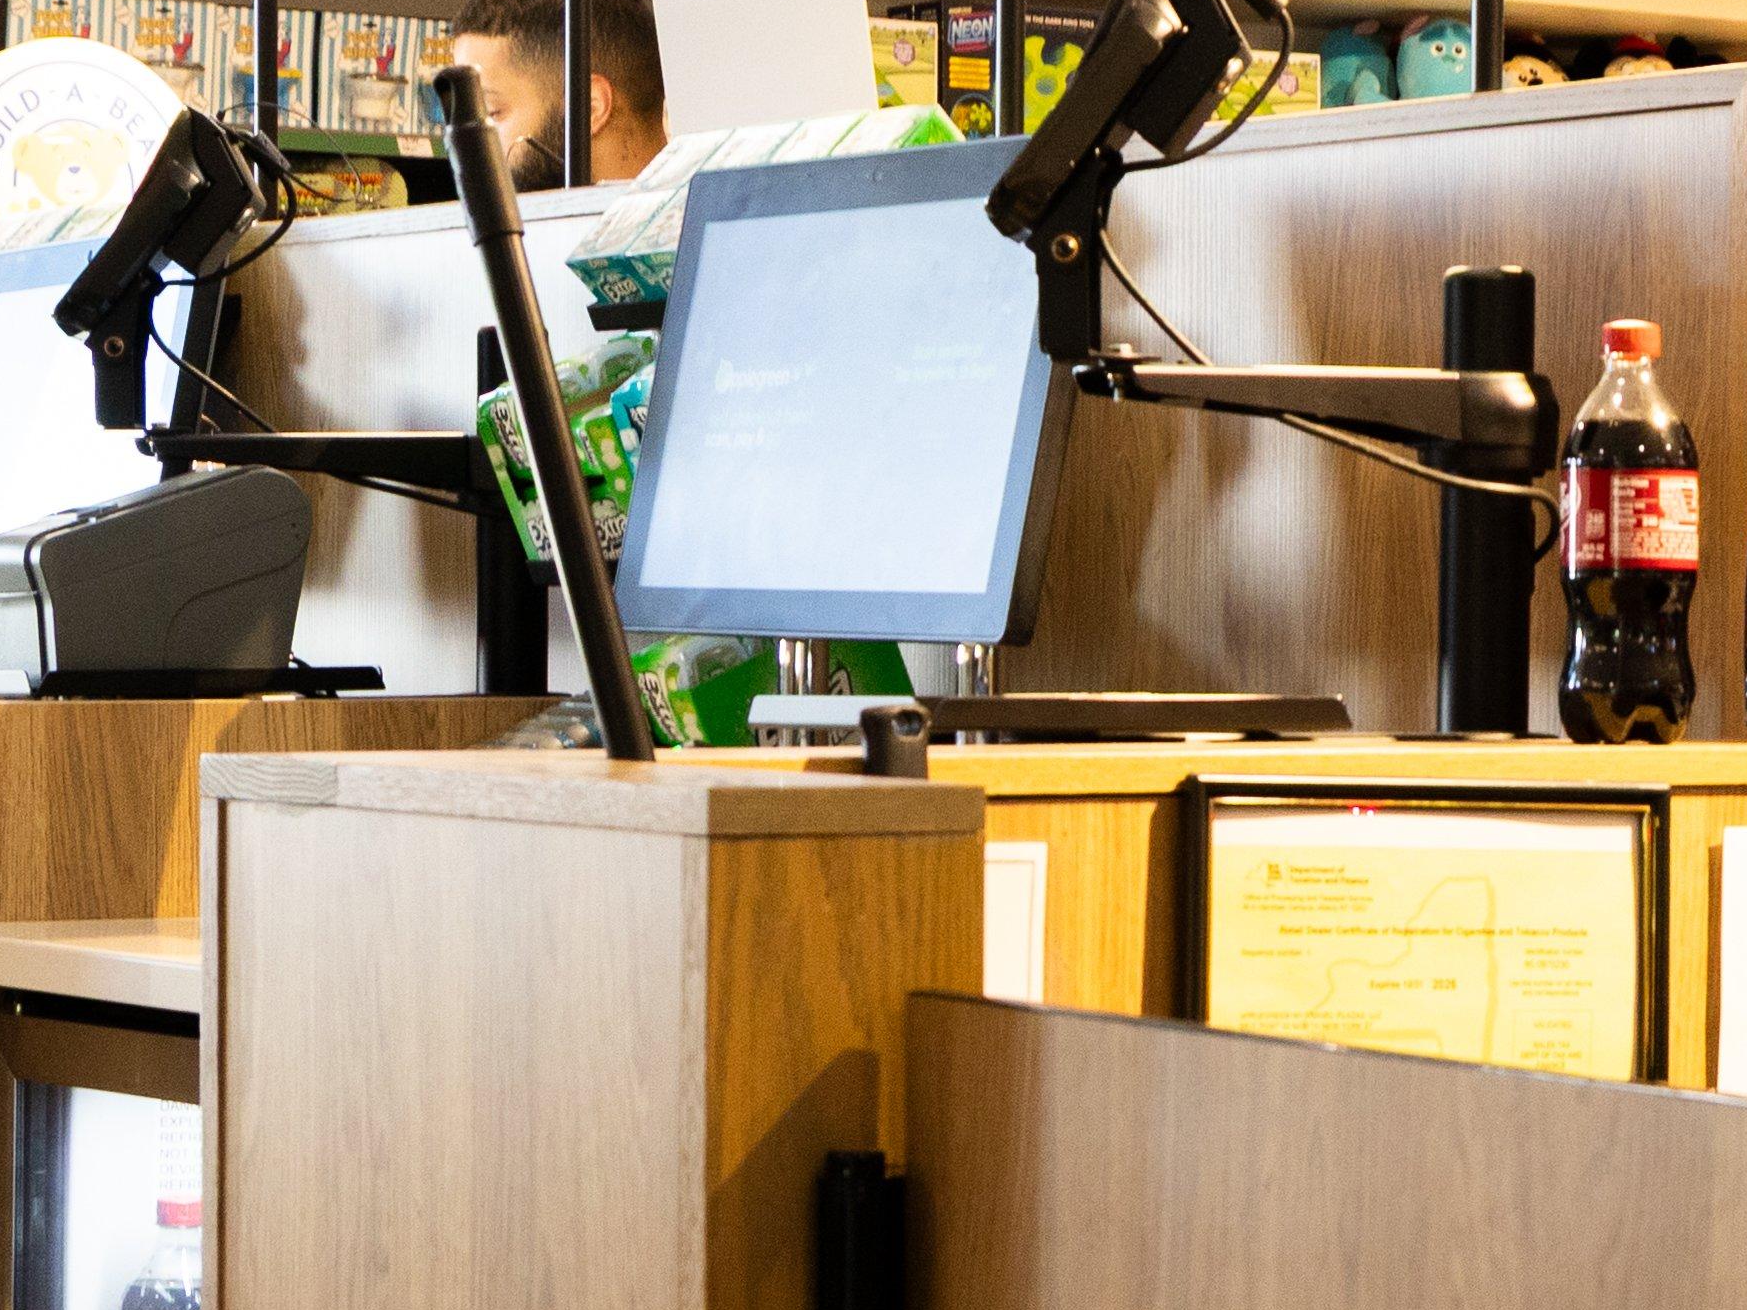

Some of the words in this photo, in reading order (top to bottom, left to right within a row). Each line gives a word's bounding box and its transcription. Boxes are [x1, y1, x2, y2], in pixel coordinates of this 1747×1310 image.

[952, 15, 993, 39] NEON
[65, 83, 86, 104] A
[110, 99, 156, 157] BEA
[1335, 925, 1379, 937] Certificate
[1392, 925, 1440, 938] Registration
